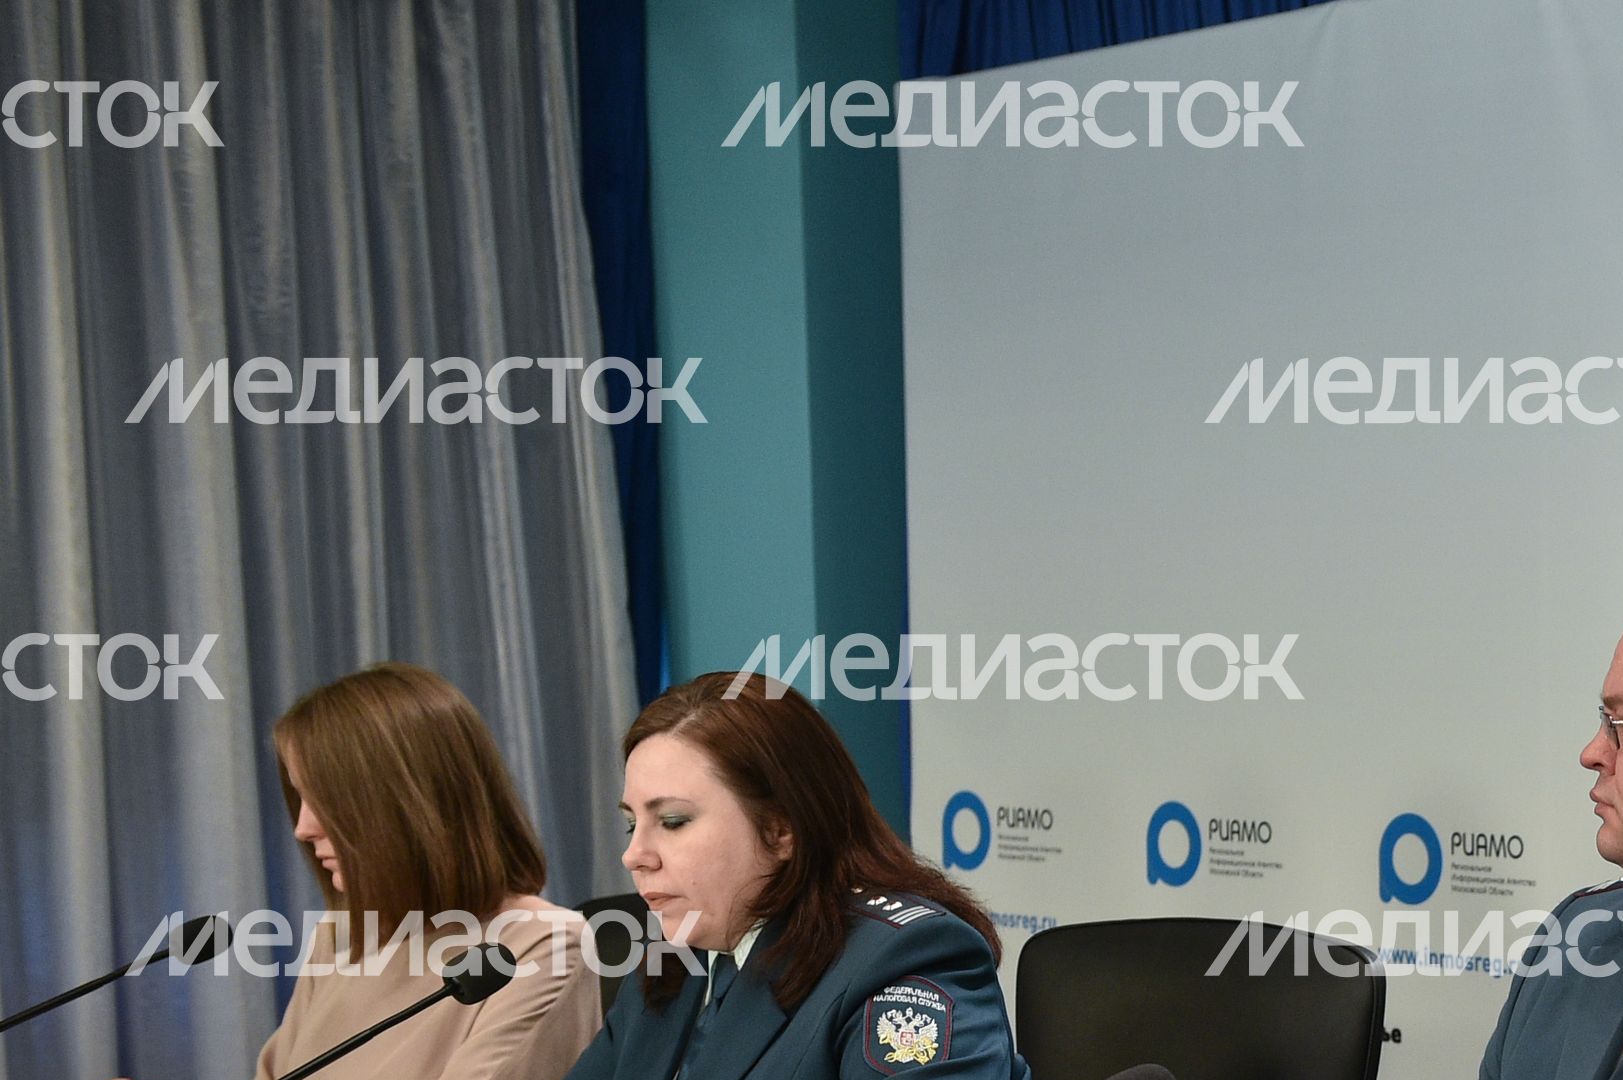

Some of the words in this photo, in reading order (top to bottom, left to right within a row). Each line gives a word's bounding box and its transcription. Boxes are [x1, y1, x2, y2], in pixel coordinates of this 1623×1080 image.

[997, 806, 1054, 830] РИАМО
[1208, 818, 1272, 843] РИАМО
[1451, 832, 1524, 859] РИАМО
[1378, 947, 1518, 978] www.inmosreg.r
